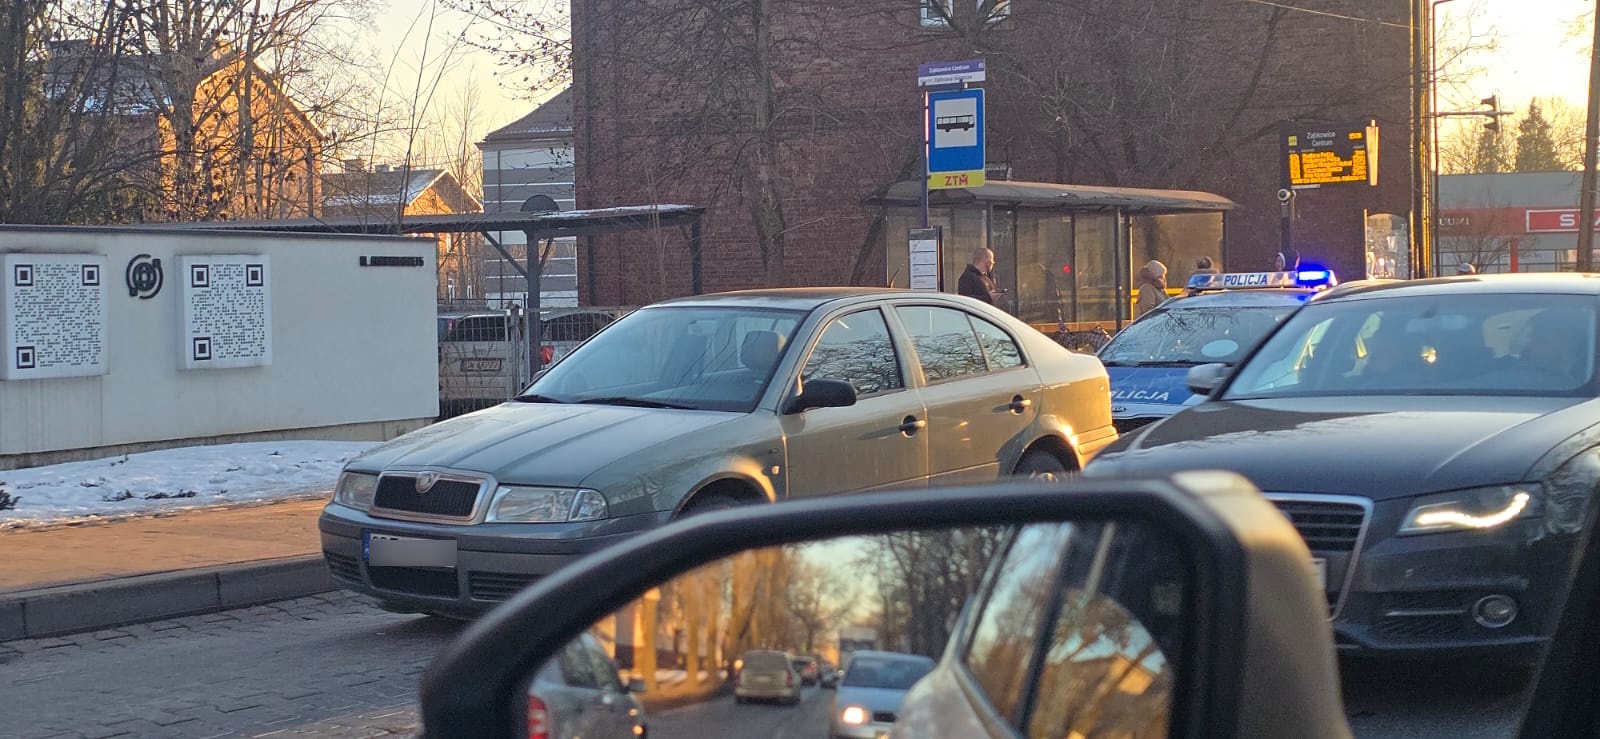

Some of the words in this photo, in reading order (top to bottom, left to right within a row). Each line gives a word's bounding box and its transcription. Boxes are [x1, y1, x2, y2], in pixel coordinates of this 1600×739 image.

[945, 174, 969, 187] ZTM
[1224, 274, 1268, 286] POLICJA
[1110, 390, 1169, 401] LICJA
